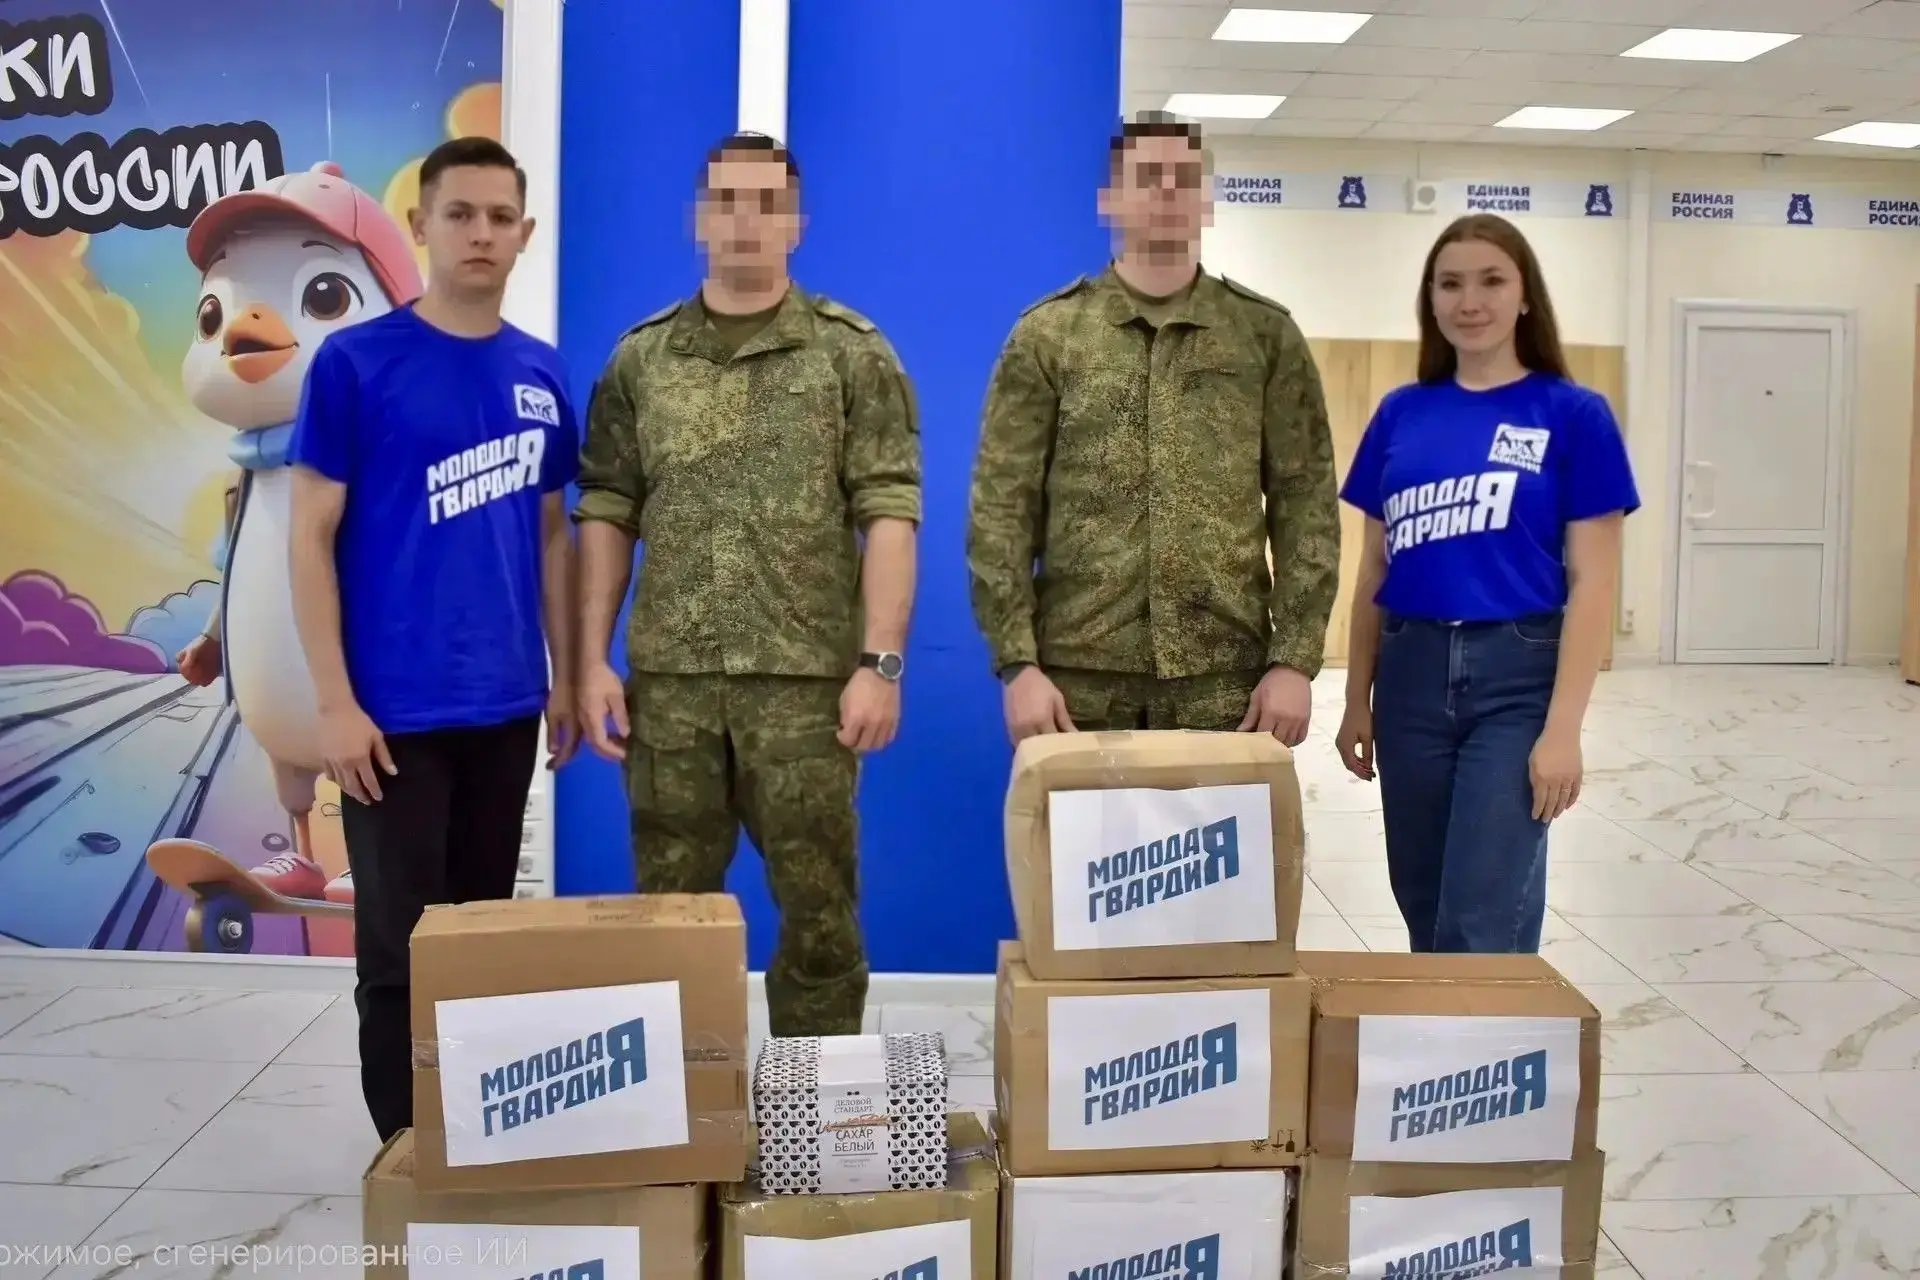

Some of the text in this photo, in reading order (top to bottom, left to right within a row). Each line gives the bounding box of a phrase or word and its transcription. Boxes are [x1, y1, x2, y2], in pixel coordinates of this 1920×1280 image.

[1219, 177, 1282, 189] ДИНАЯ
[1222, 191, 1282, 204] ОССИЯ
[1672, 193, 1734, 205] ЕДИНАЯ
[1672, 206, 1734, 219] РОССИЯ
[1869, 213, 1920, 226] РОССИ
[1087, 815, 1239, 889] МОЛОДАЯ
[480, 1017, 647, 1102] МОЛОДАЯ
[1085, 1022, 1237, 1093] МОЛОДАЯ
[1393, 1049, 1546, 1115] МОЛОДАЯ
[835, 1128, 874, 1140] САХАР
[834, 1139, 875, 1152] БЕЛЫЙ
